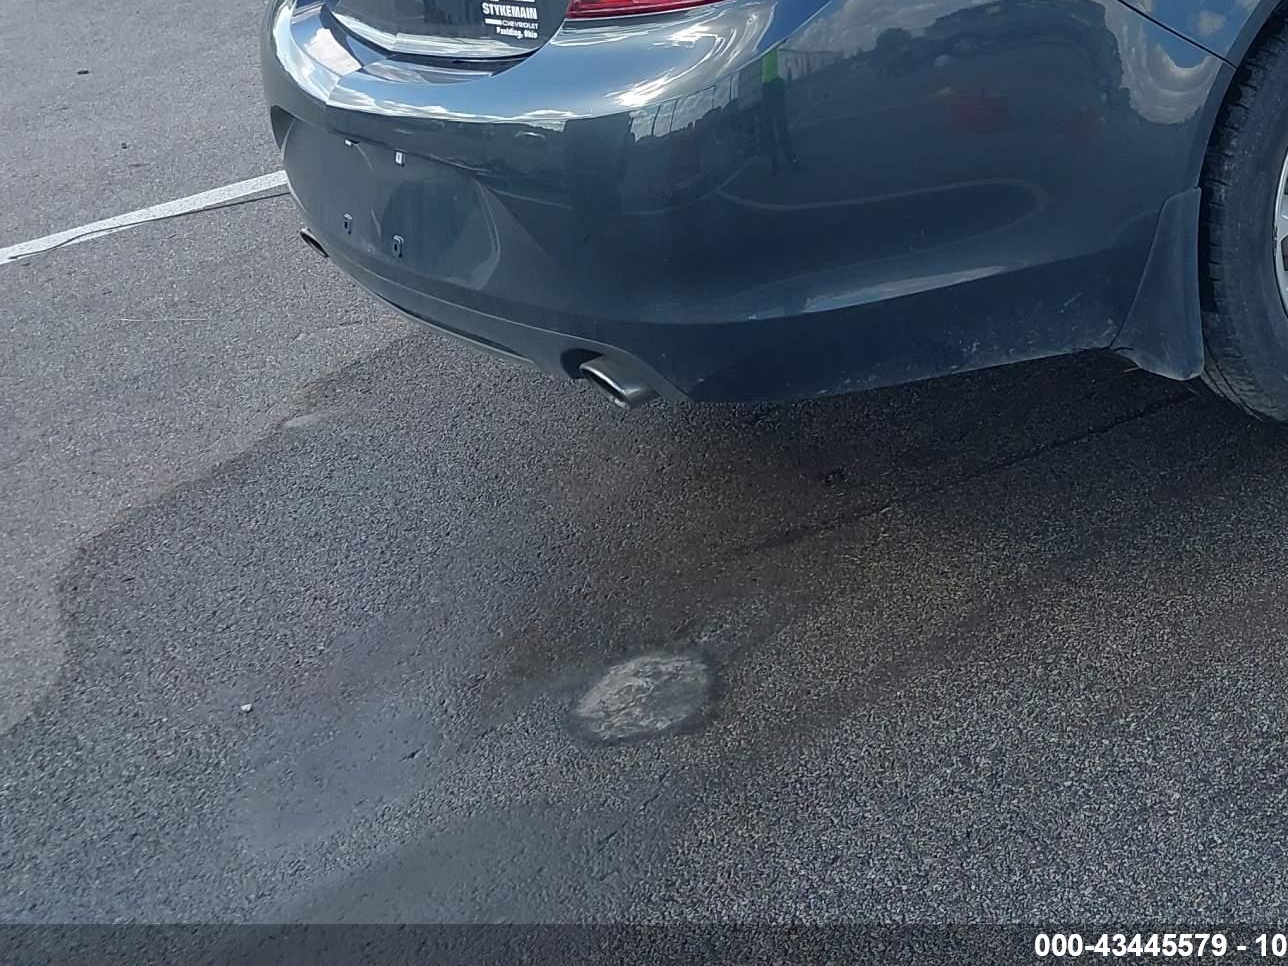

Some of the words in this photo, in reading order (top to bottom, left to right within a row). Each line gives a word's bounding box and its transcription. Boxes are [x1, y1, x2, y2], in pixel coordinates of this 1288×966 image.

[482, 2, 538, 20] STYKEMAIN
[502, 19, 539, 30] CHEVROLET
[523, 29, 538, 39] Ohio
